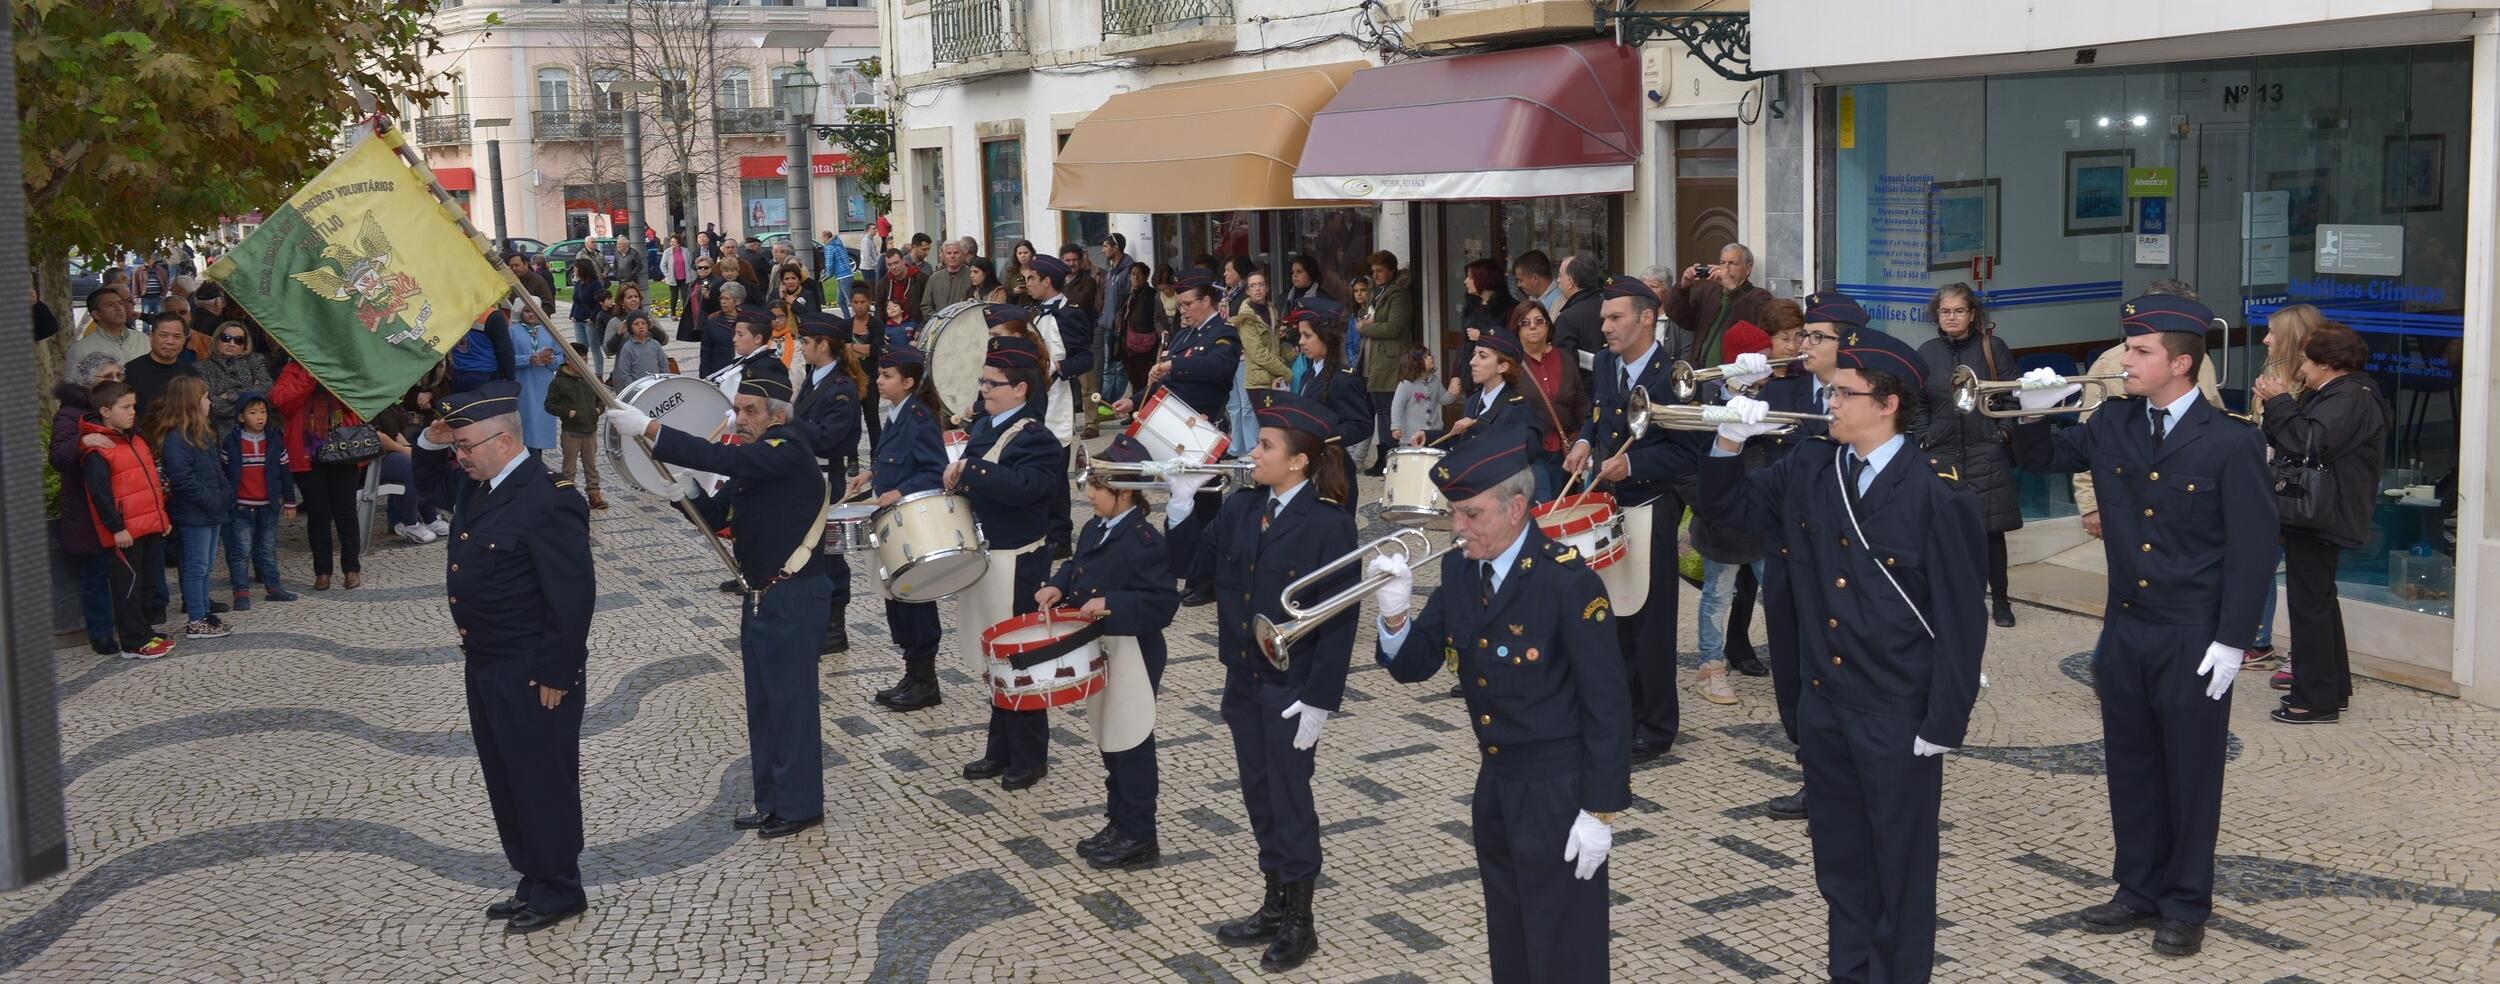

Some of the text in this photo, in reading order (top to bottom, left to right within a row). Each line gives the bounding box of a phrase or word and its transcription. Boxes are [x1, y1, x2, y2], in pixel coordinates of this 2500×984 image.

[2258, 83, 2284, 103] 13
[335, 179, 394, 197] VOLUNTÁRIOS
[298, 214, 345, 252] MONTIJO
[2287, 277, 2446, 304] Análises Clínicas
[649, 392, 684, 419] ANGER
